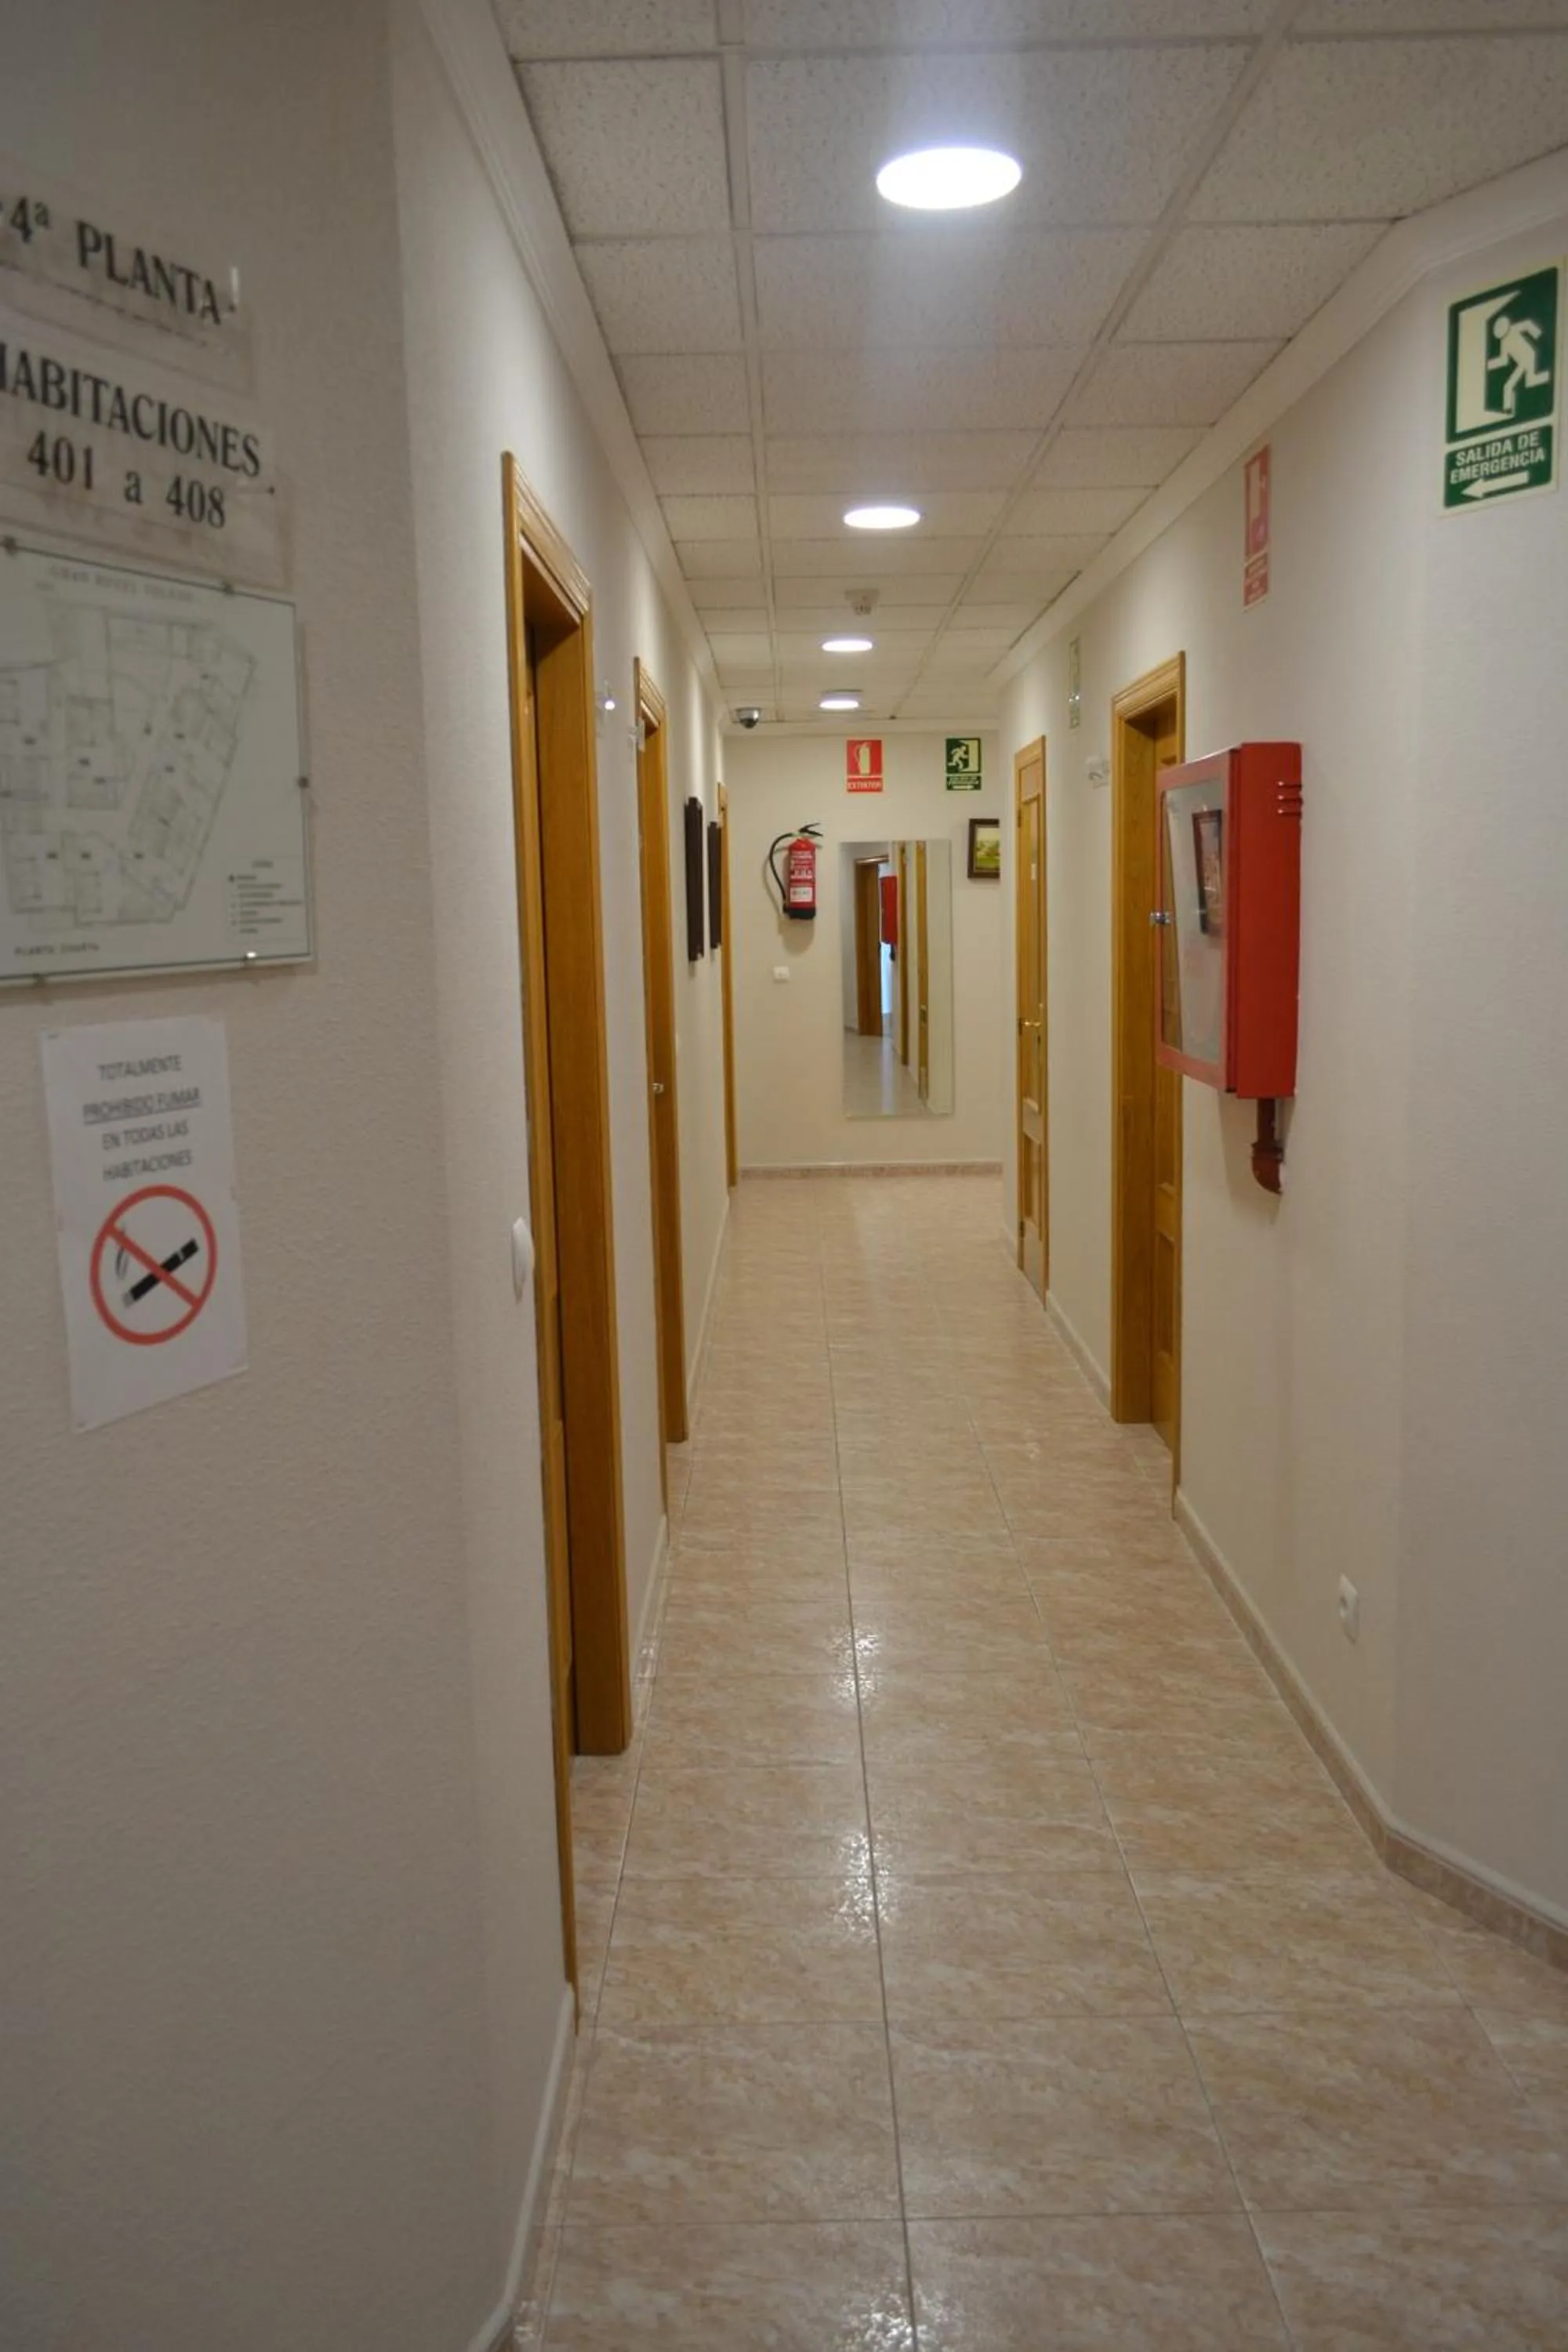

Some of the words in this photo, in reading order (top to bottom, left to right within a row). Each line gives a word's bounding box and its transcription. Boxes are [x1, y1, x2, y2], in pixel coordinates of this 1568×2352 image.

[74, 220, 221, 325] PLANTA
[1456, 438, 1513, 466] SALIDA
[1519, 431, 1540, 449] DE
[27, 430, 94, 491] 401
[124, 470, 143, 505] a
[165, 475, 227, 529] 408
[1450, 448, 1546, 485] EMERGENCIA
[97, 1054, 182, 1080] TOTALMENTE
[102, 1132, 121, 1150] EN
[122, 1123, 165, 1145] TODAS
[168, 1120, 189, 1138] LAS
[103, 1149, 192, 1181] HABITACIONES
